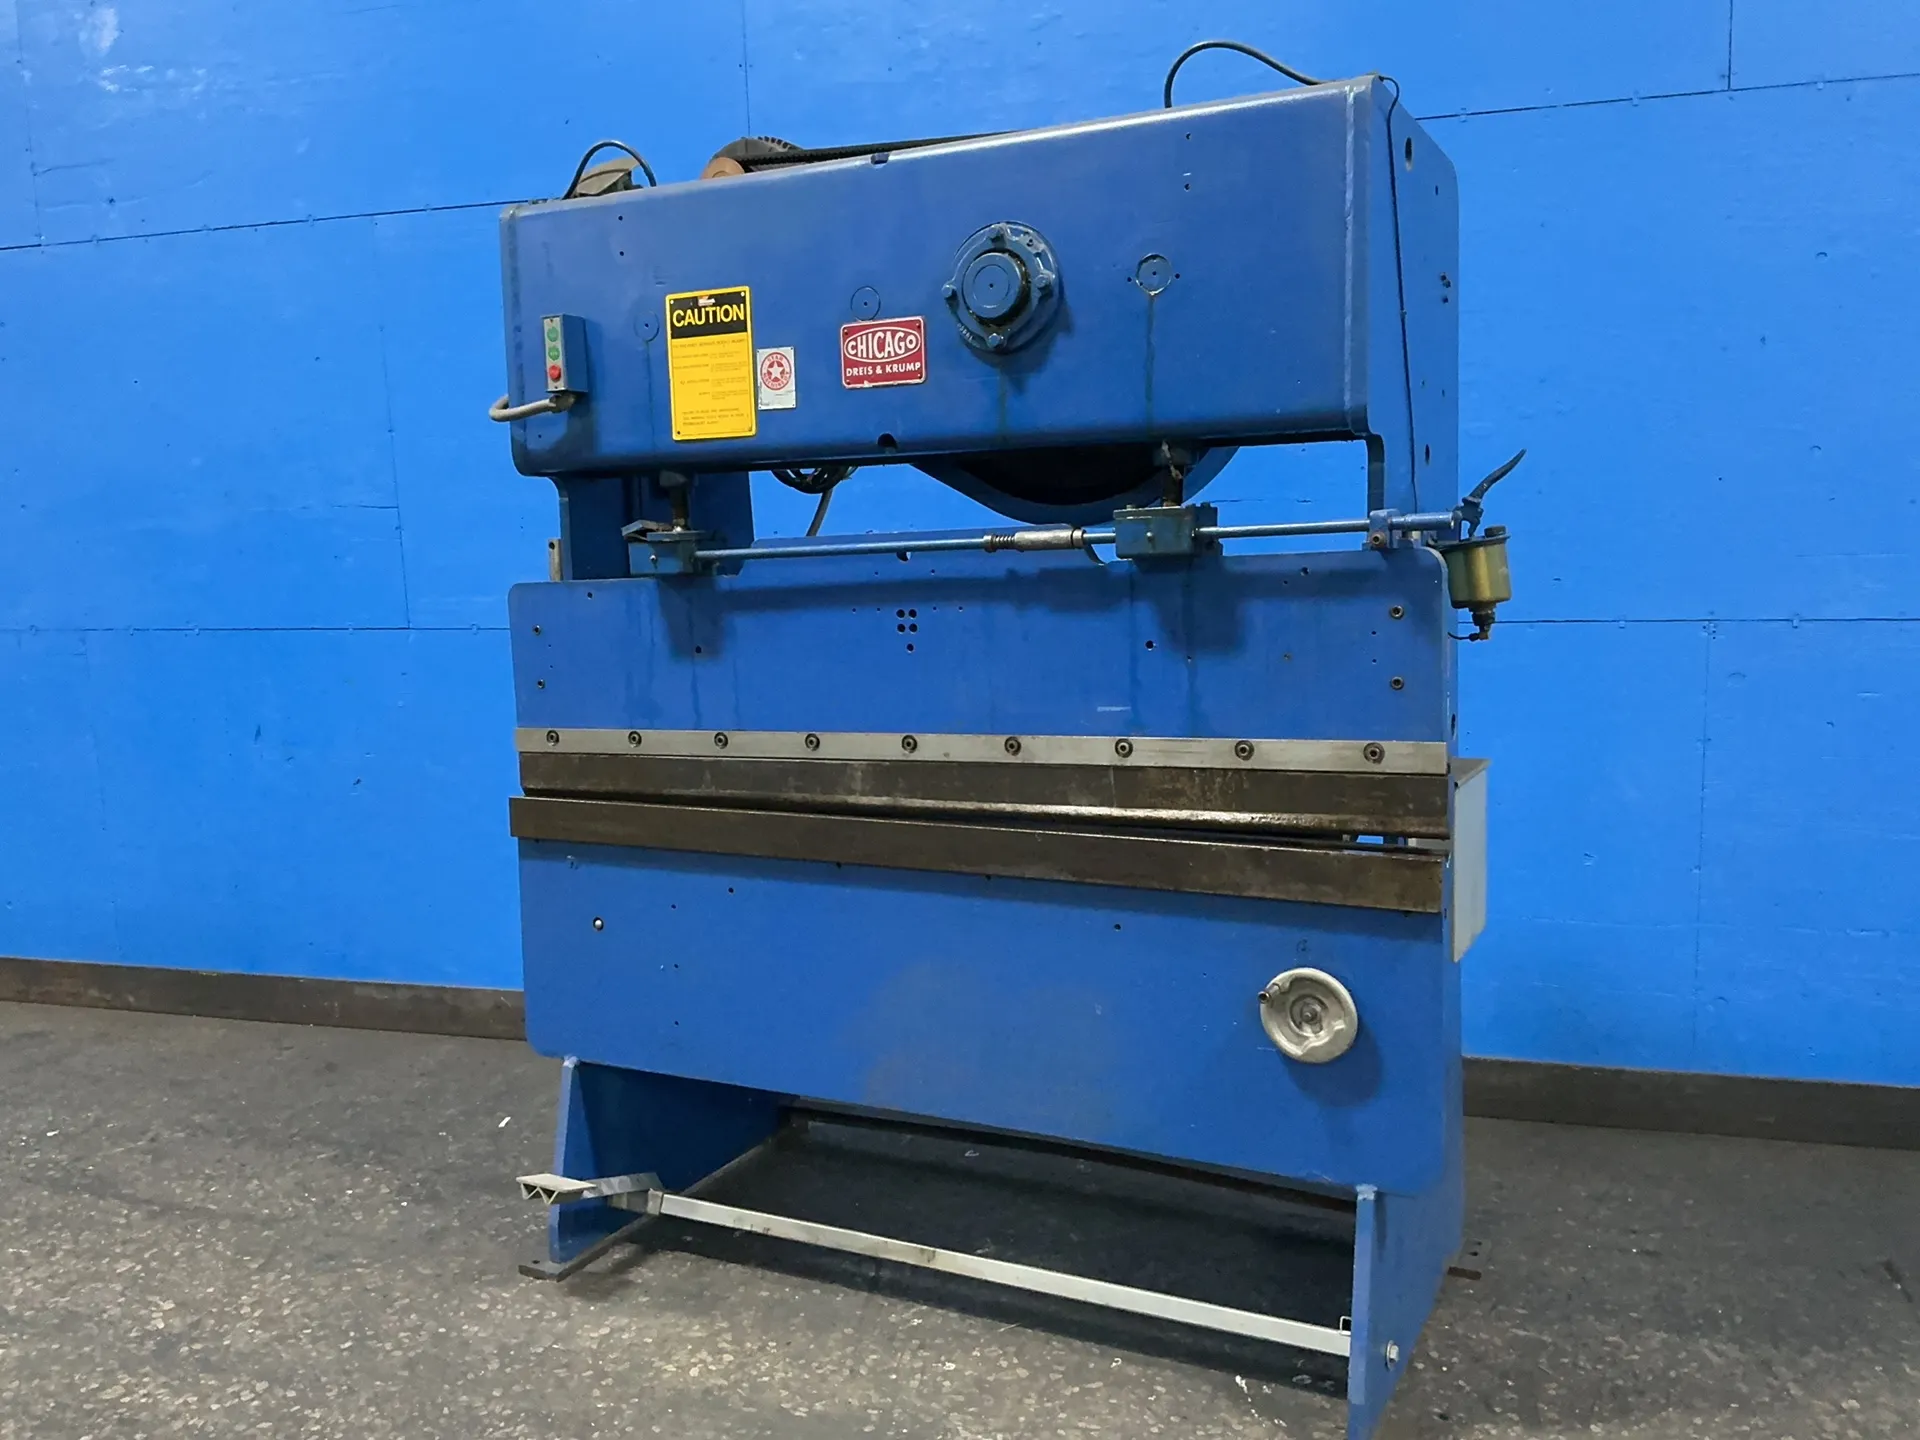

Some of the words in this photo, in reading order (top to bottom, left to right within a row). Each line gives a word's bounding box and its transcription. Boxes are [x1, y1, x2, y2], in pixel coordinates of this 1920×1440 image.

[672, 303, 745, 327] CAUTION
[847, 331, 917, 359] CHICAGO
[846, 366, 873, 377] DREIS
[875, 365, 883, 375] &
[885, 361, 921, 374] KRUMP
